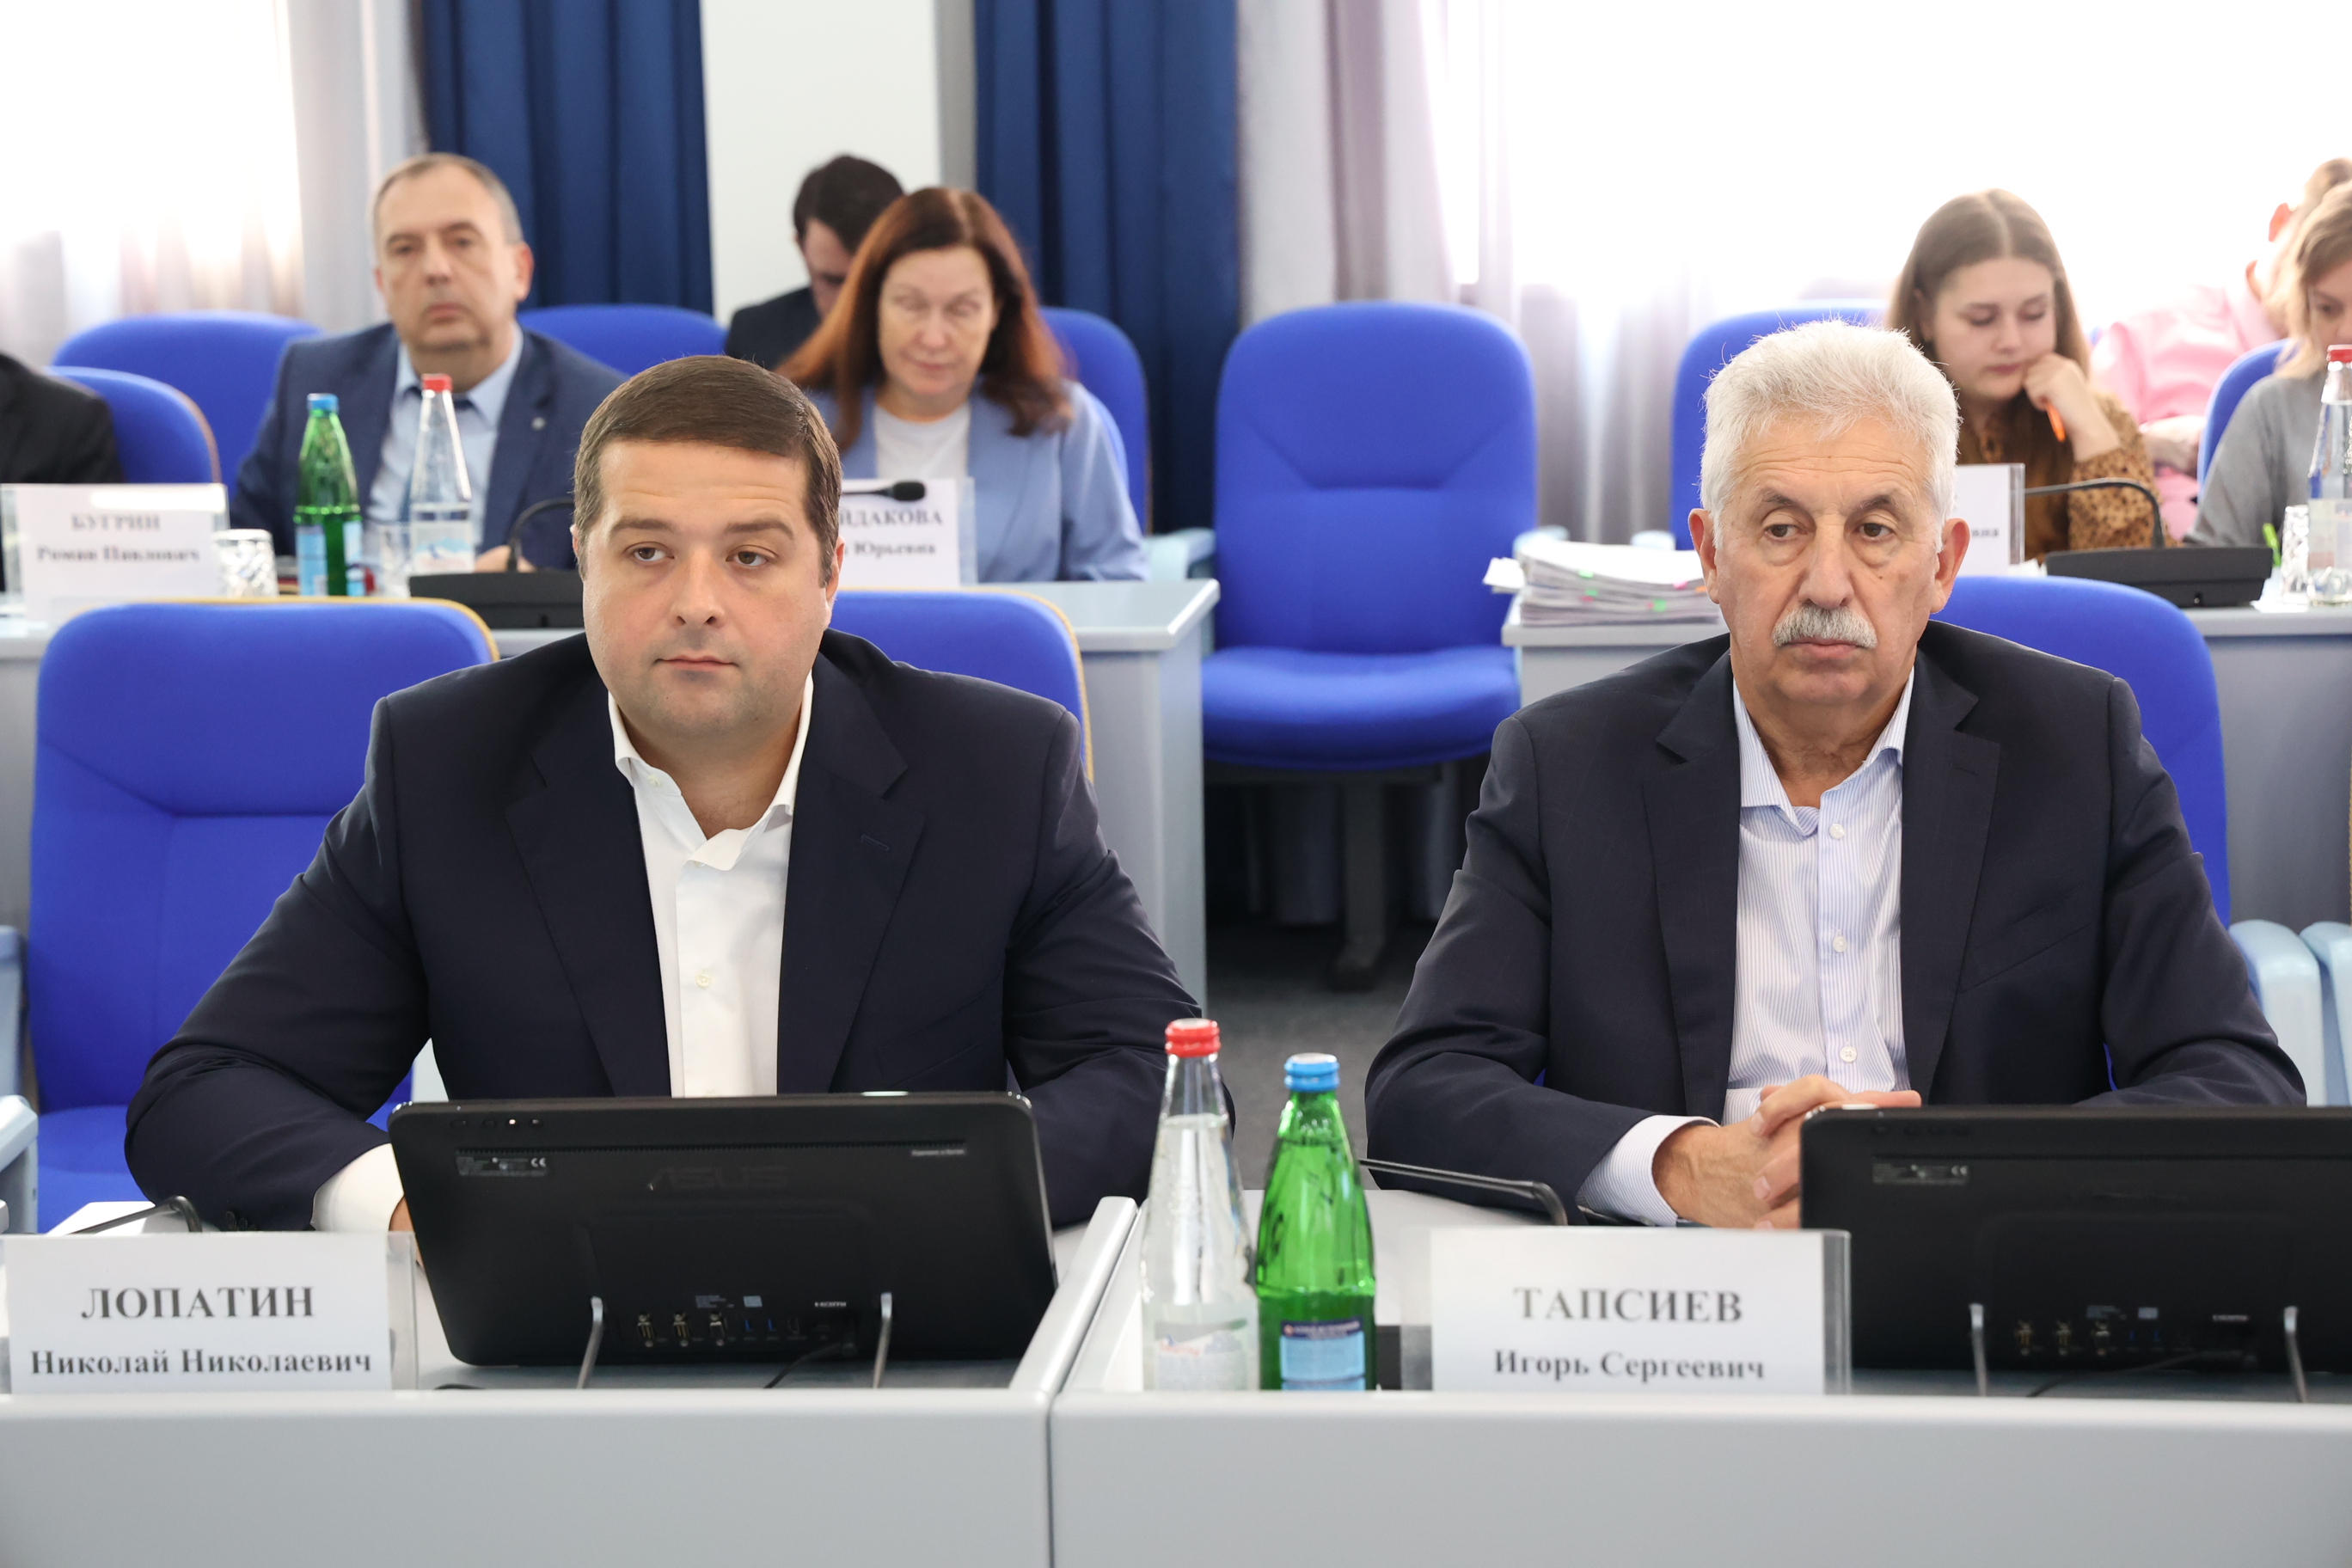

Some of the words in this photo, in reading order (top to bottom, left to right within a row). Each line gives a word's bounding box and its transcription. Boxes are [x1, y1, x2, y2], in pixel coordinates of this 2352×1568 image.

[70, 514, 161, 530] БУГРИН
[37, 546, 98, 562] Роман
[81, 1287, 314, 1320] ЛОПАТИН
[1513, 1288, 1743, 1323] ТАПСИЕВ
[31, 1350, 168, 1375] Николай
[181, 1348, 371, 1374] Николаевич
[1494, 1350, 1589, 1381] Игорь
[1601, 1351, 1765, 1383] Сергеевич
